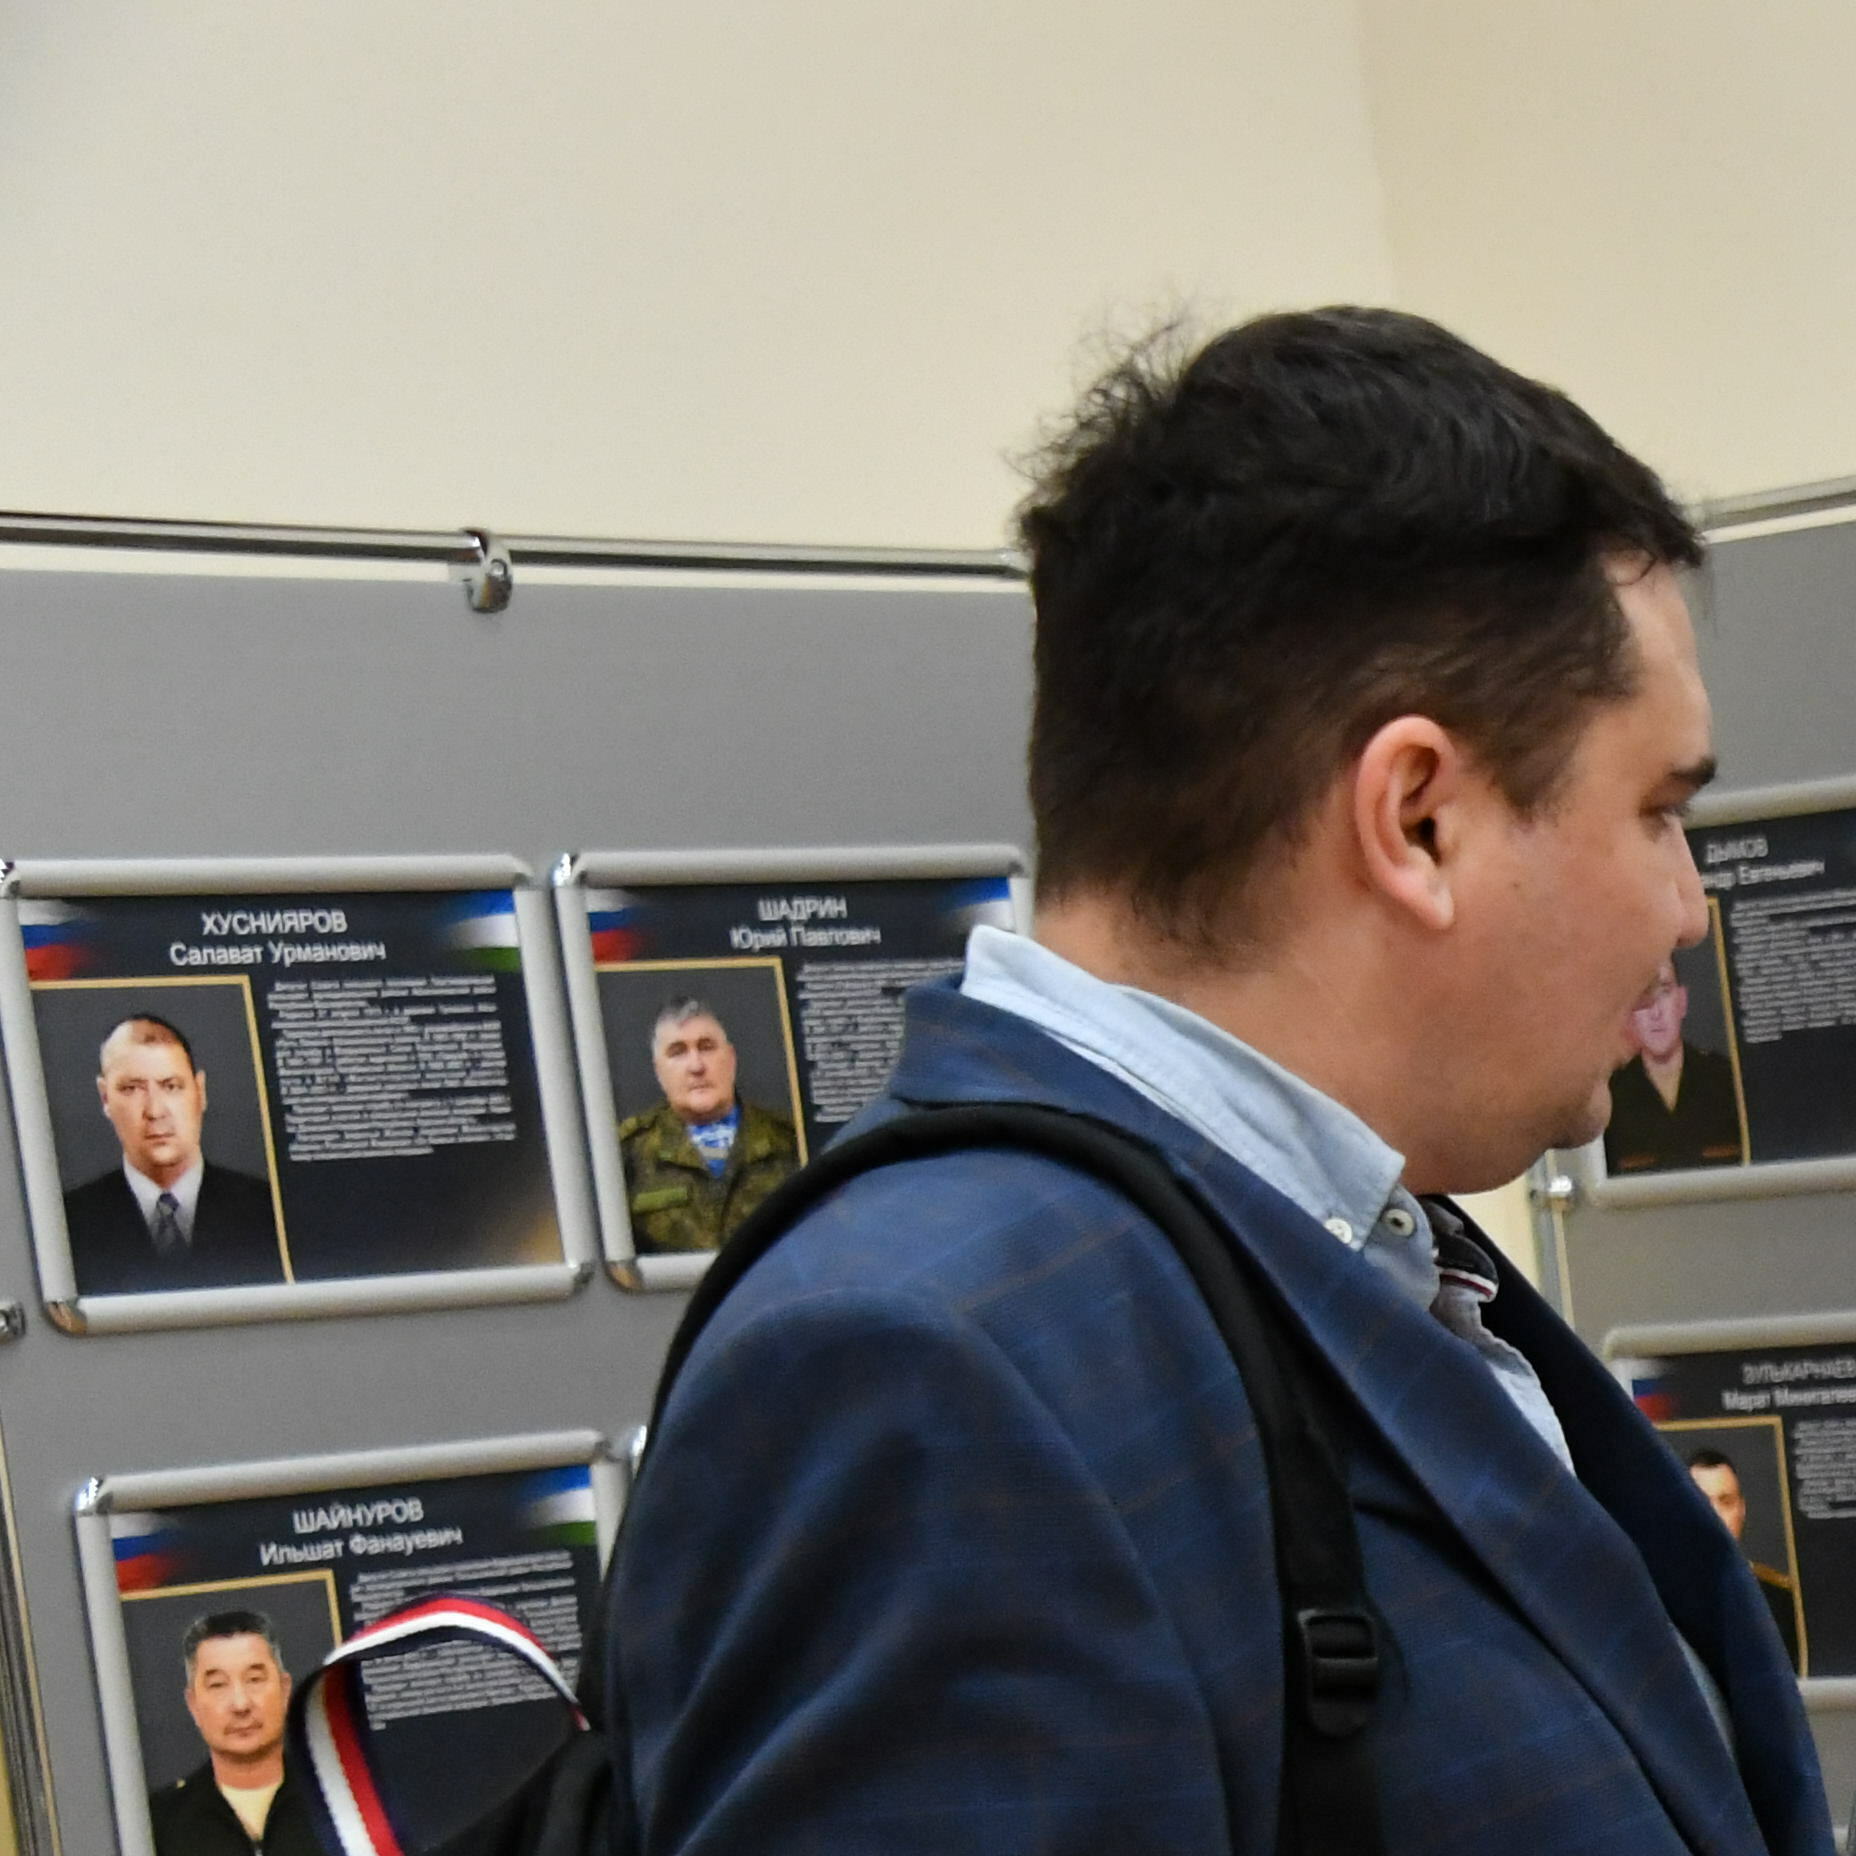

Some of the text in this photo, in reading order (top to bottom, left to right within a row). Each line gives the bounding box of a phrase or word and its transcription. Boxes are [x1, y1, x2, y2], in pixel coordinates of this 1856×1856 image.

[201, 909, 348, 936] ХУСНИЯРОВ
[757, 896, 848, 921] ШАДРИН
[728, 923, 881, 952] Юрий Павлович
[170, 939, 386, 967] Салават Урманович
[293, 1496, 424, 1534] ШАЙНУРОВ
[259, 1525, 463, 1566] Ильшат Фанауевич
